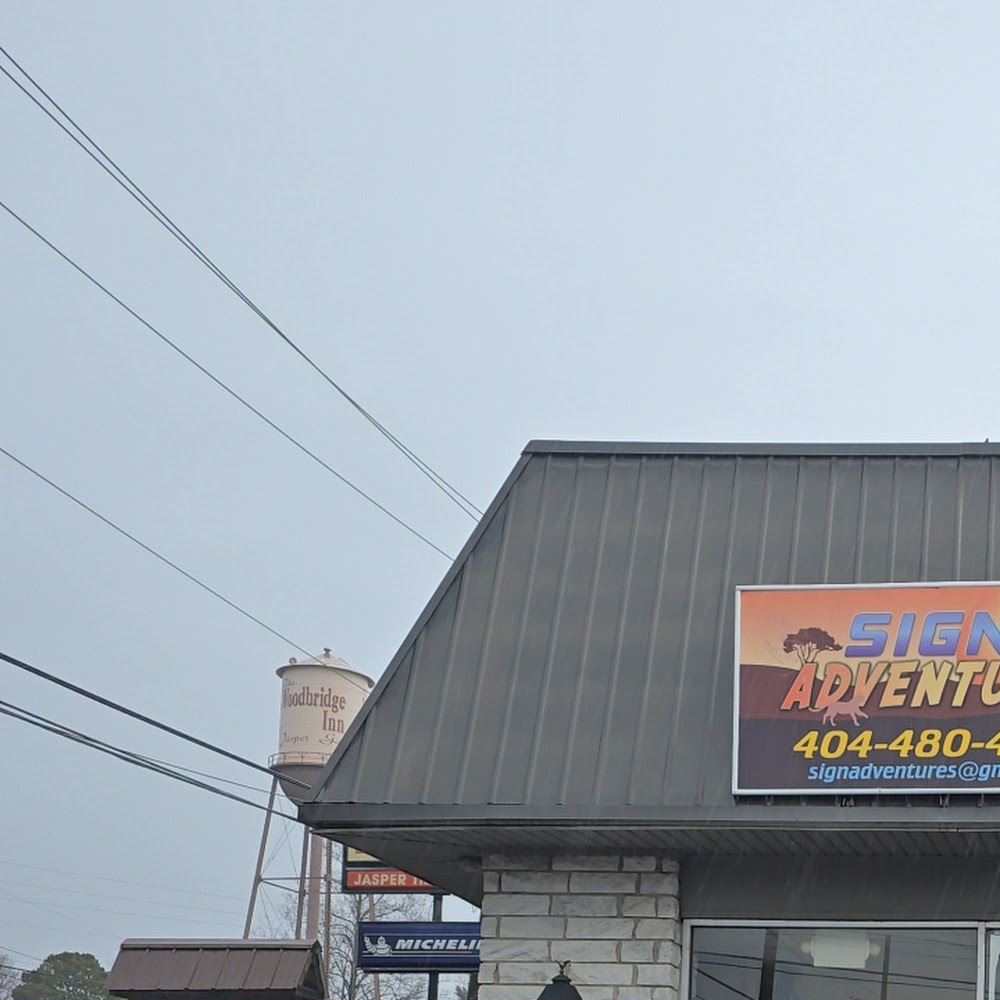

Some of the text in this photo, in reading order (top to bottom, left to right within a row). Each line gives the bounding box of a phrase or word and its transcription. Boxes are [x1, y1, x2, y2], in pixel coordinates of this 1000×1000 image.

[322, 710, 345, 733] Inn
[354, 874, 407, 886] JASPER
[395, 939, 480, 950] MICHELI
